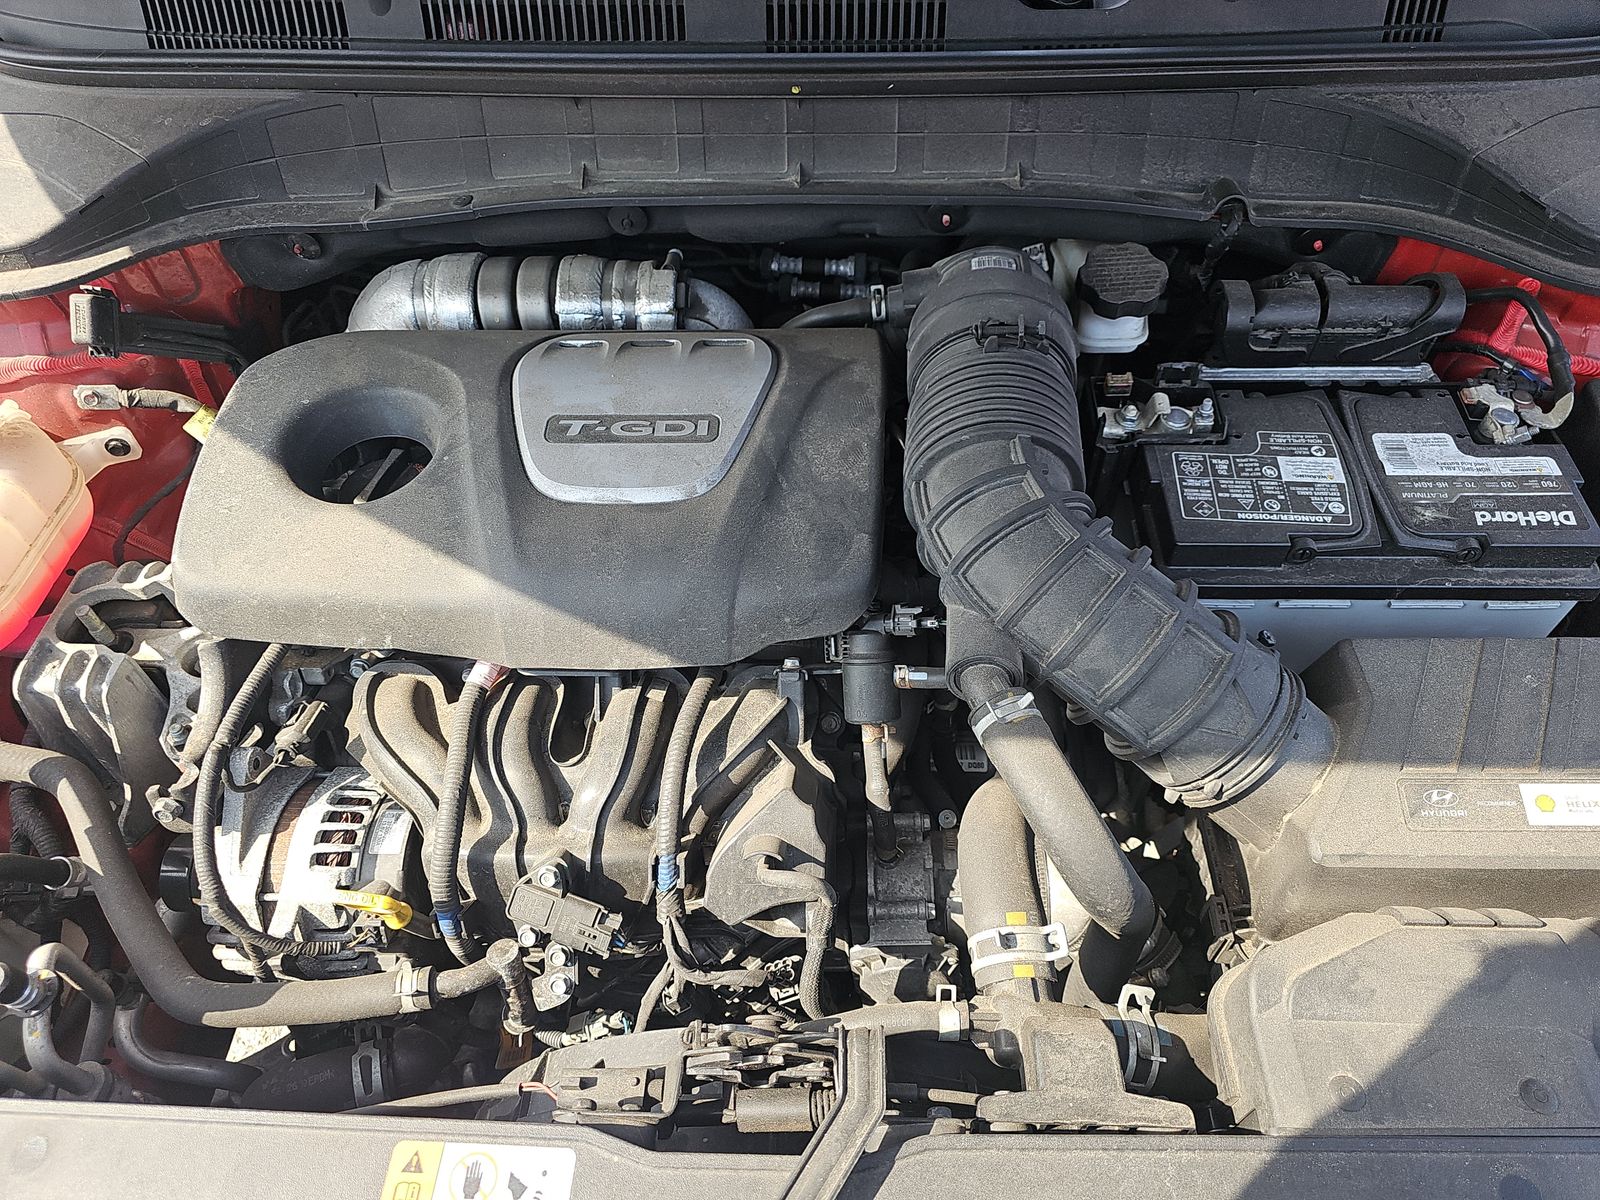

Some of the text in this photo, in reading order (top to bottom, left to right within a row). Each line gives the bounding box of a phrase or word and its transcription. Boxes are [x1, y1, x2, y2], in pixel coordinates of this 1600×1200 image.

[558, 419, 709, 437] T-GDI
[1237, 513, 1322, 523] DANGER/POISON
[1475, 510, 1577, 526] DieHard
[1421, 809, 1468, 817] HYUNDAI
